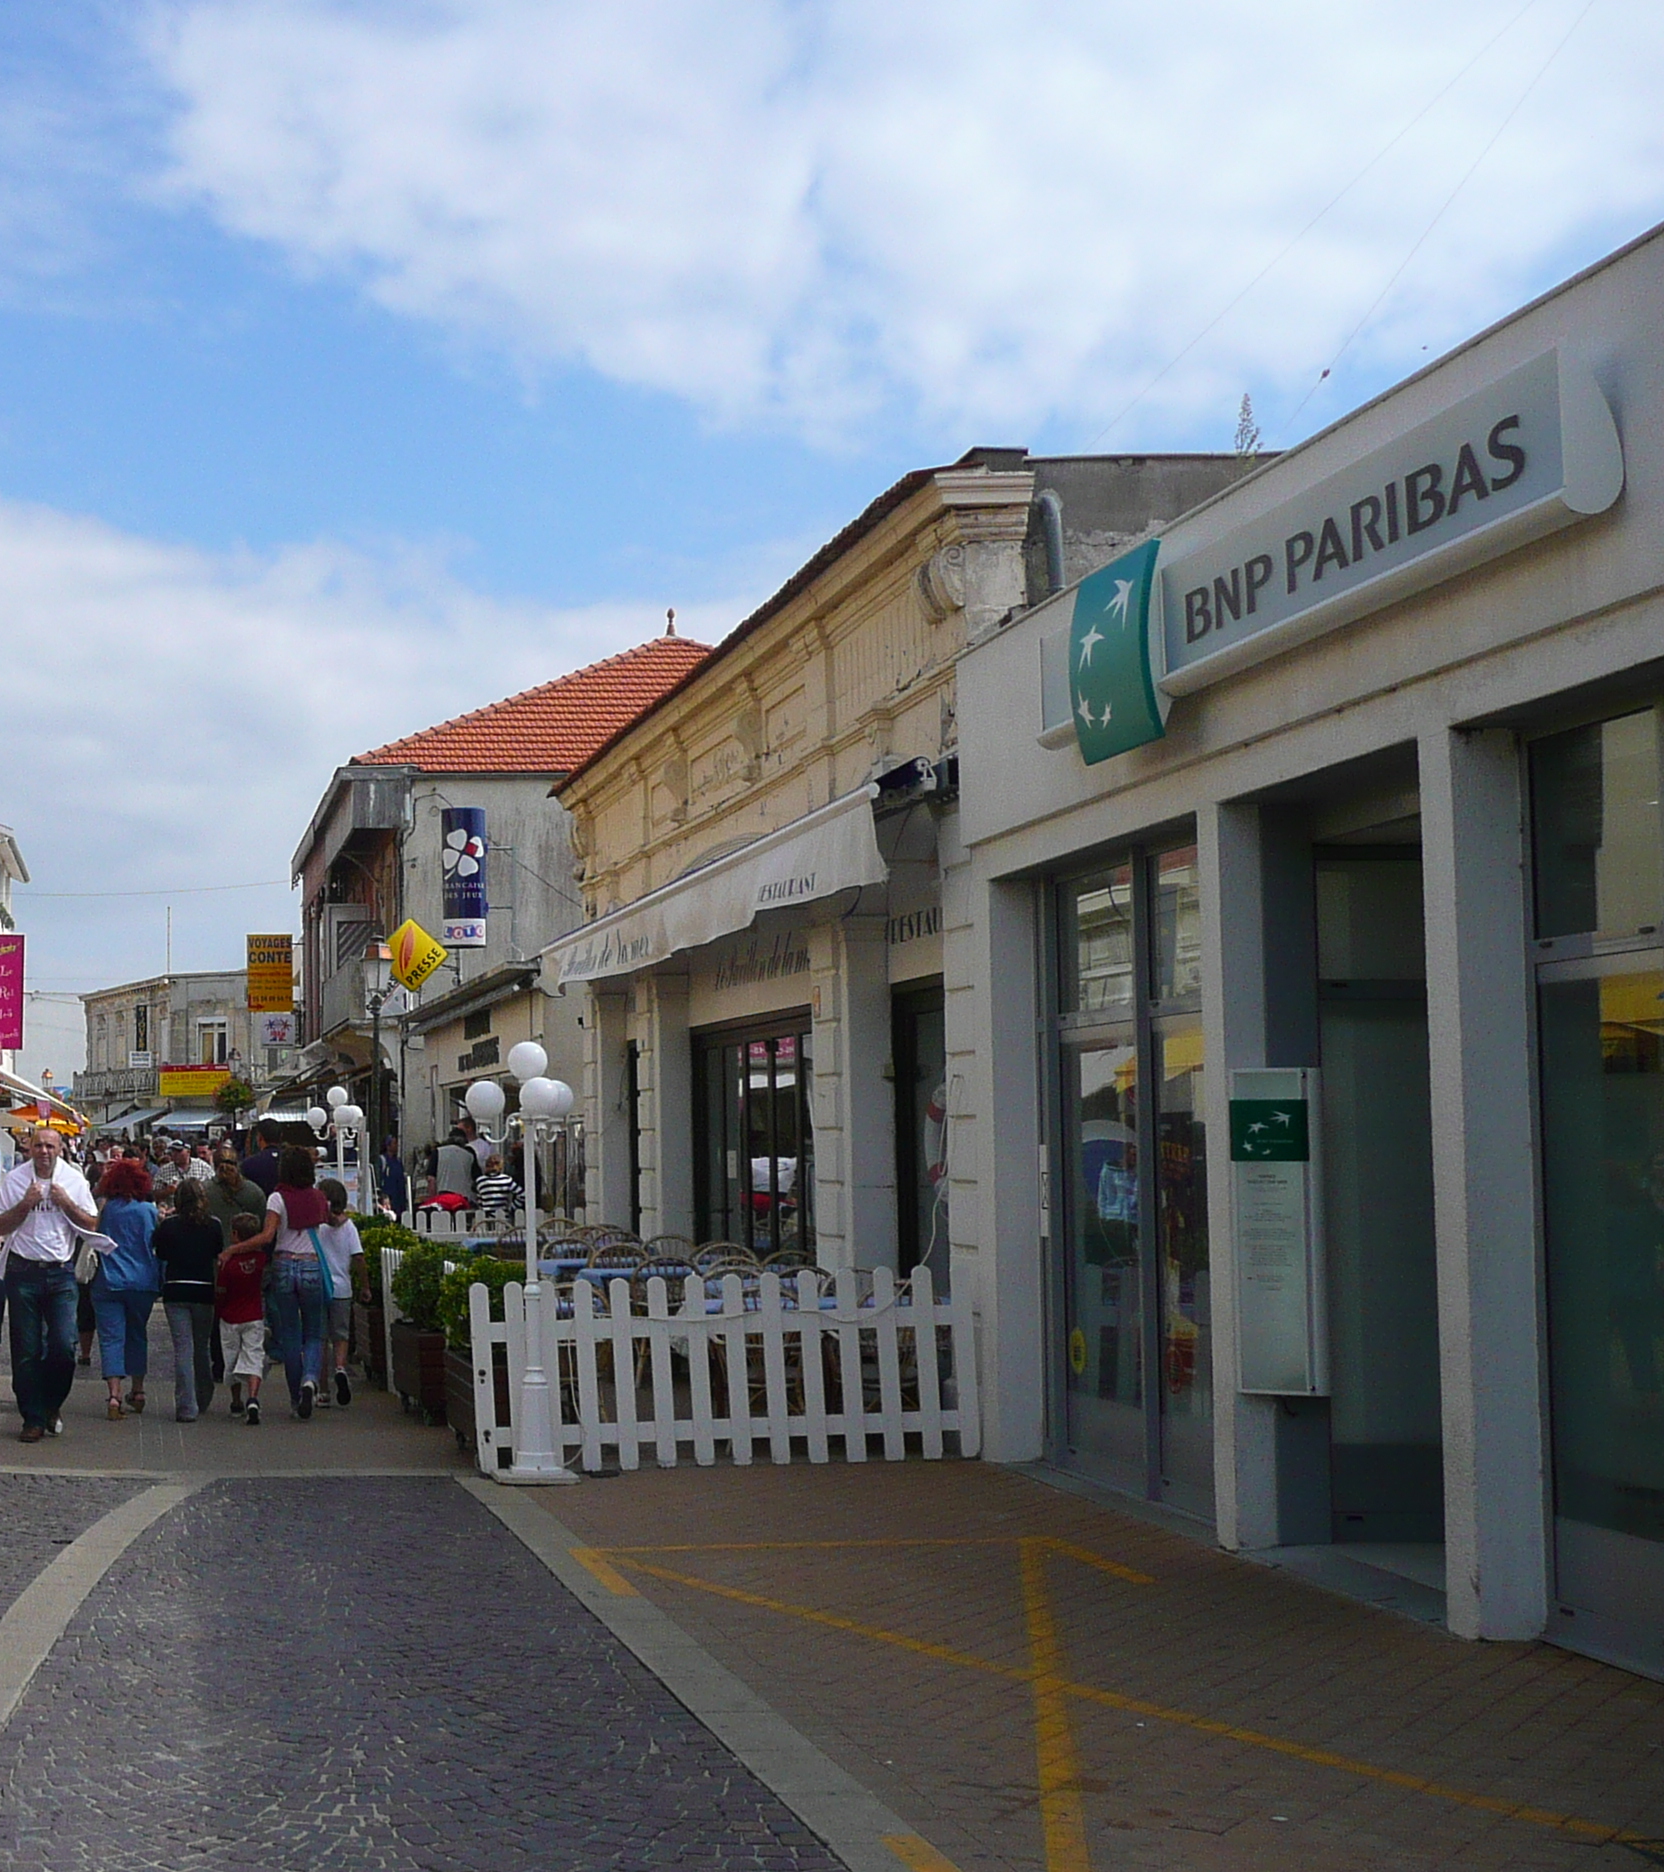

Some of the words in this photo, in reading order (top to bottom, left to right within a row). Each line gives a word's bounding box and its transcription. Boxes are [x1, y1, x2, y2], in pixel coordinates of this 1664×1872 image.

[1184, 553, 1273, 644] BNP
[1285, 414, 1526, 595] PARIBAS
[248, 938, 292, 949] VOYAGES
[443, 925, 485, 939] LOTO
[249, 951, 292, 964] CONTE
[598, 932, 612, 970] de
[617, 928, 628, 965] la
[405, 948, 442, 986] PRESSE
